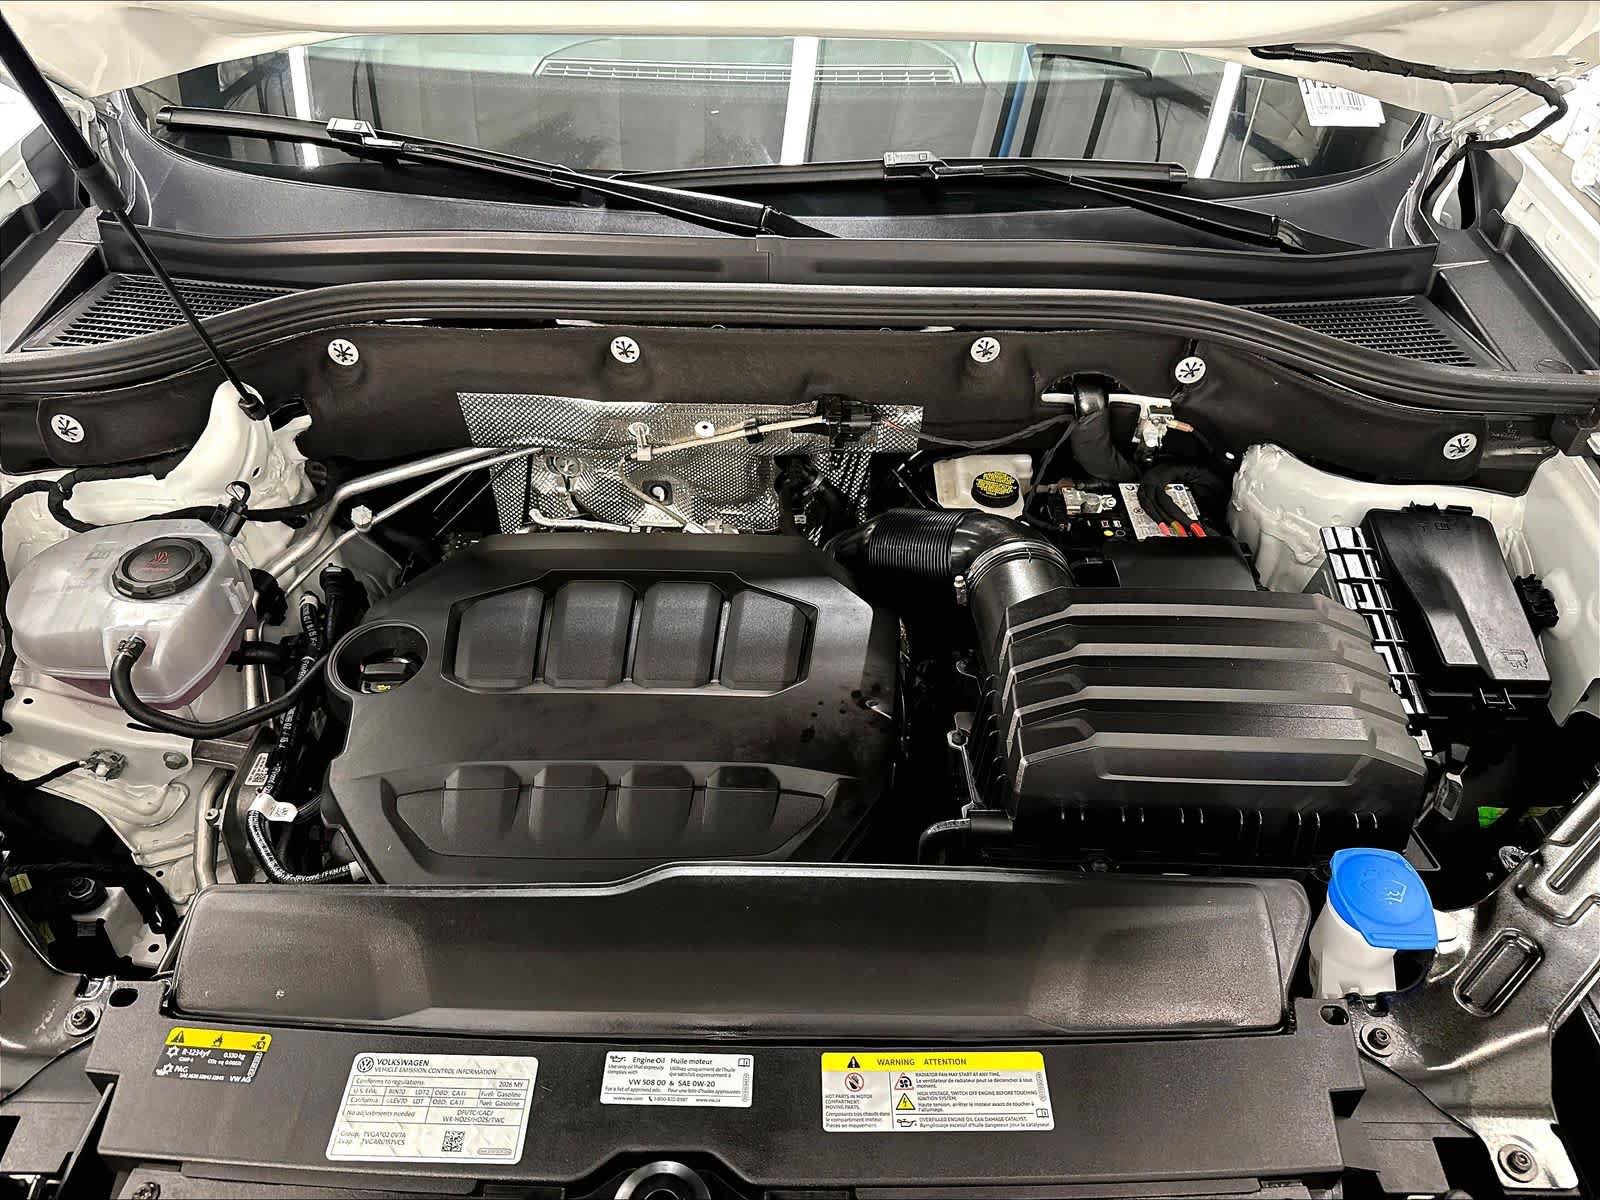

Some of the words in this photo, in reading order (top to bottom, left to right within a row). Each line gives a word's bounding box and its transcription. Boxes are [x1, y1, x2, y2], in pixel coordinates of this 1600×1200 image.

[181, 1048, 211, 1059] R-1234yf
[376, 1058, 430, 1067] VOLKSWAGEN
[632, 1056, 655, 1065] Engine
[670, 1057, 688, 1065] Huile
[877, 1058, 916, 1066] WARNING
[924, 1058, 967, 1066] ATTENTION
[173, 1065, 190, 1074] PAG
[398, 1066, 427, 1074] EMISSION
[456, 1068, 497, 1076] INFORMATION
[692, 1080, 716, 1088] 0W-20
